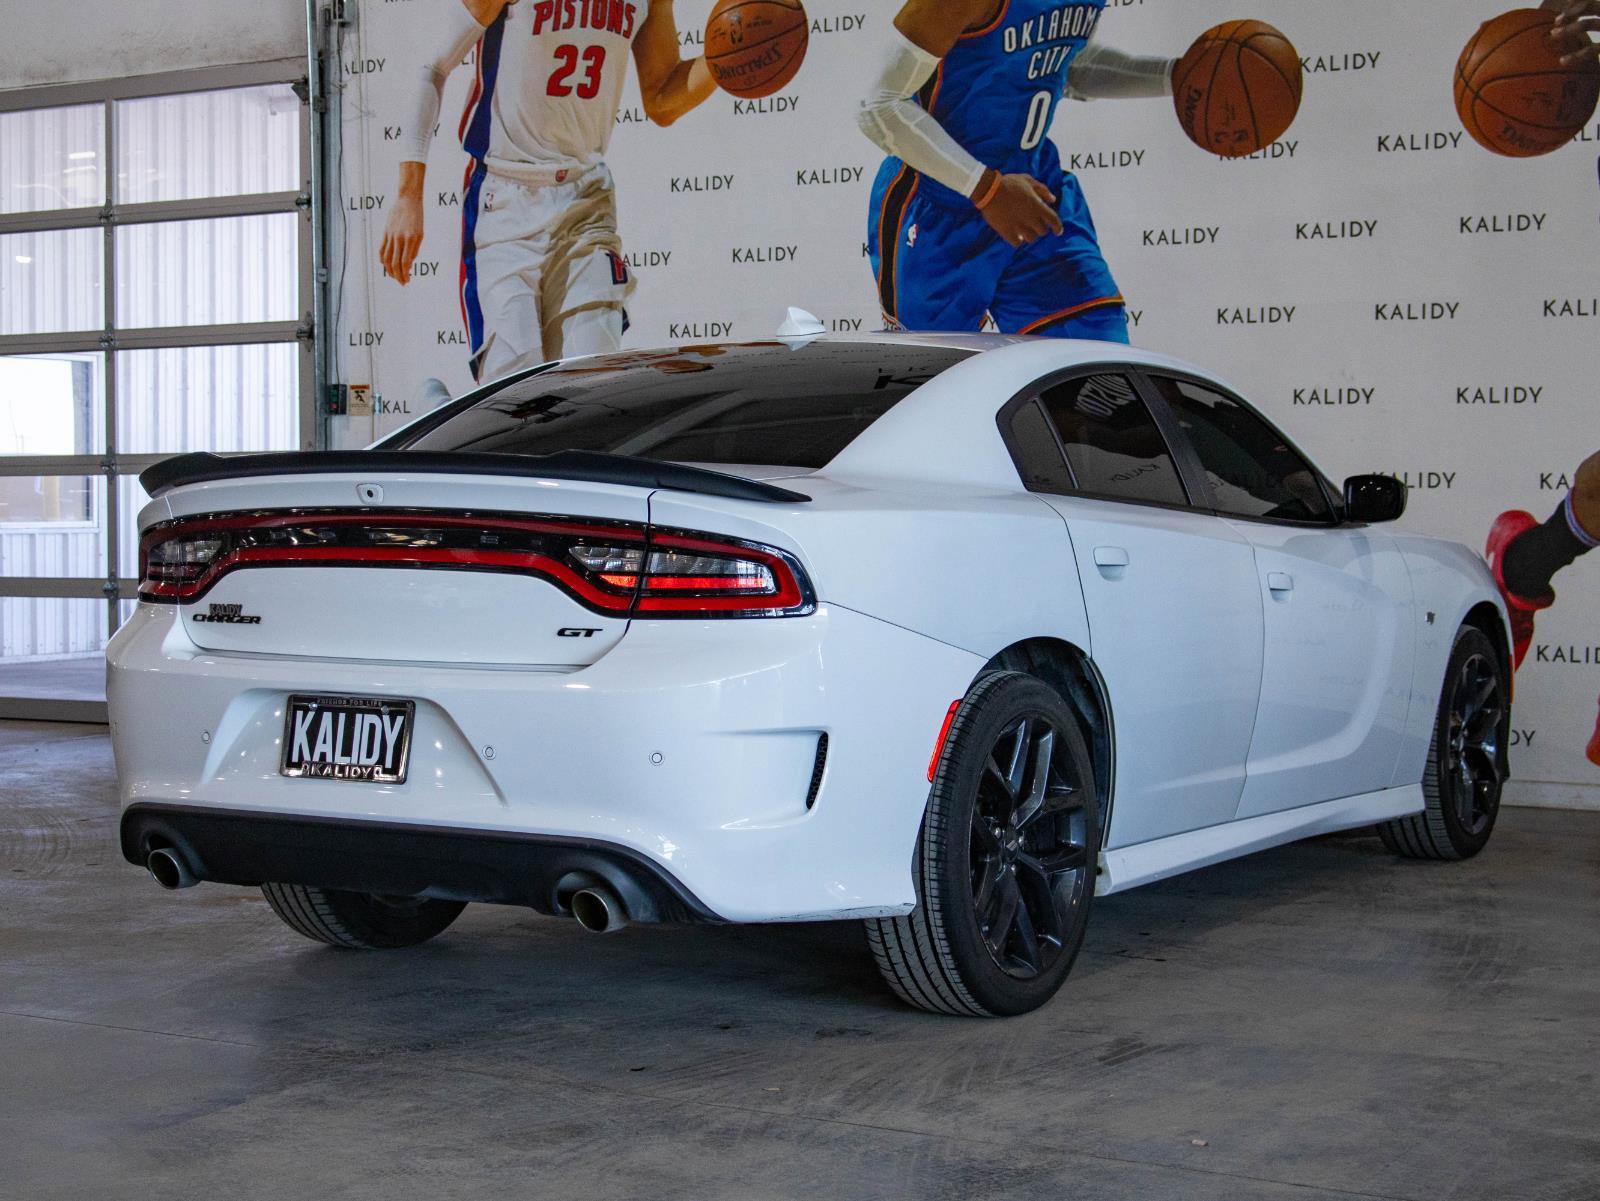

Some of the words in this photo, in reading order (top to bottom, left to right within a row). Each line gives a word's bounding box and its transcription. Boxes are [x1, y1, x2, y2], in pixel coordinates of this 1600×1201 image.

[532, 0, 636, 39] PISTONS
[810, 15, 866, 33] ALIDY
[1004, 5, 1097, 52] OKLAHOM
[345, 58, 386, 75] LIDY
[546, 44, 606, 99] 23
[1028, 46, 1072, 80] CITY
[1300, 51, 1381, 73] KALIDY
[734, 96, 799, 115] KALIDY
[1020, 91, 1052, 150] 0
[1377, 131, 1463, 152] KALIDY
[1070, 150, 1145, 169] KALIDY
[670, 175, 734, 193] KALIDY
[796, 167, 864, 186] KALIDY
[350, 196, 384, 211] LIDY
[1295, 219, 1378, 240] KALIDY
[1459, 213, 1547, 234] KALIDY
[1142, 226, 1220, 246] KALIDY
[623, 250, 672, 268] ALIDY
[732, 245, 798, 264] KALIDY
[1217, 306, 1296, 325] KALIDY
[1374, 302, 1460, 321] KALIDY
[1543, 298, 1597, 317] KALI
[349, 331, 384, 346] LIDY
[437, 330, 466, 345] KAL
[669, 322, 733, 338] KALIDY
[1293, 387, 1375, 405] KALIDY
[1456, 386, 1543, 404] KALIDY
[382, 400, 411, 414] KAL
[557, 627, 604, 637] GT
[1536, 644, 1600, 664] KALI
[291, 710, 405, 770] KALIDY
[311, 762, 372, 779] KALIDY
